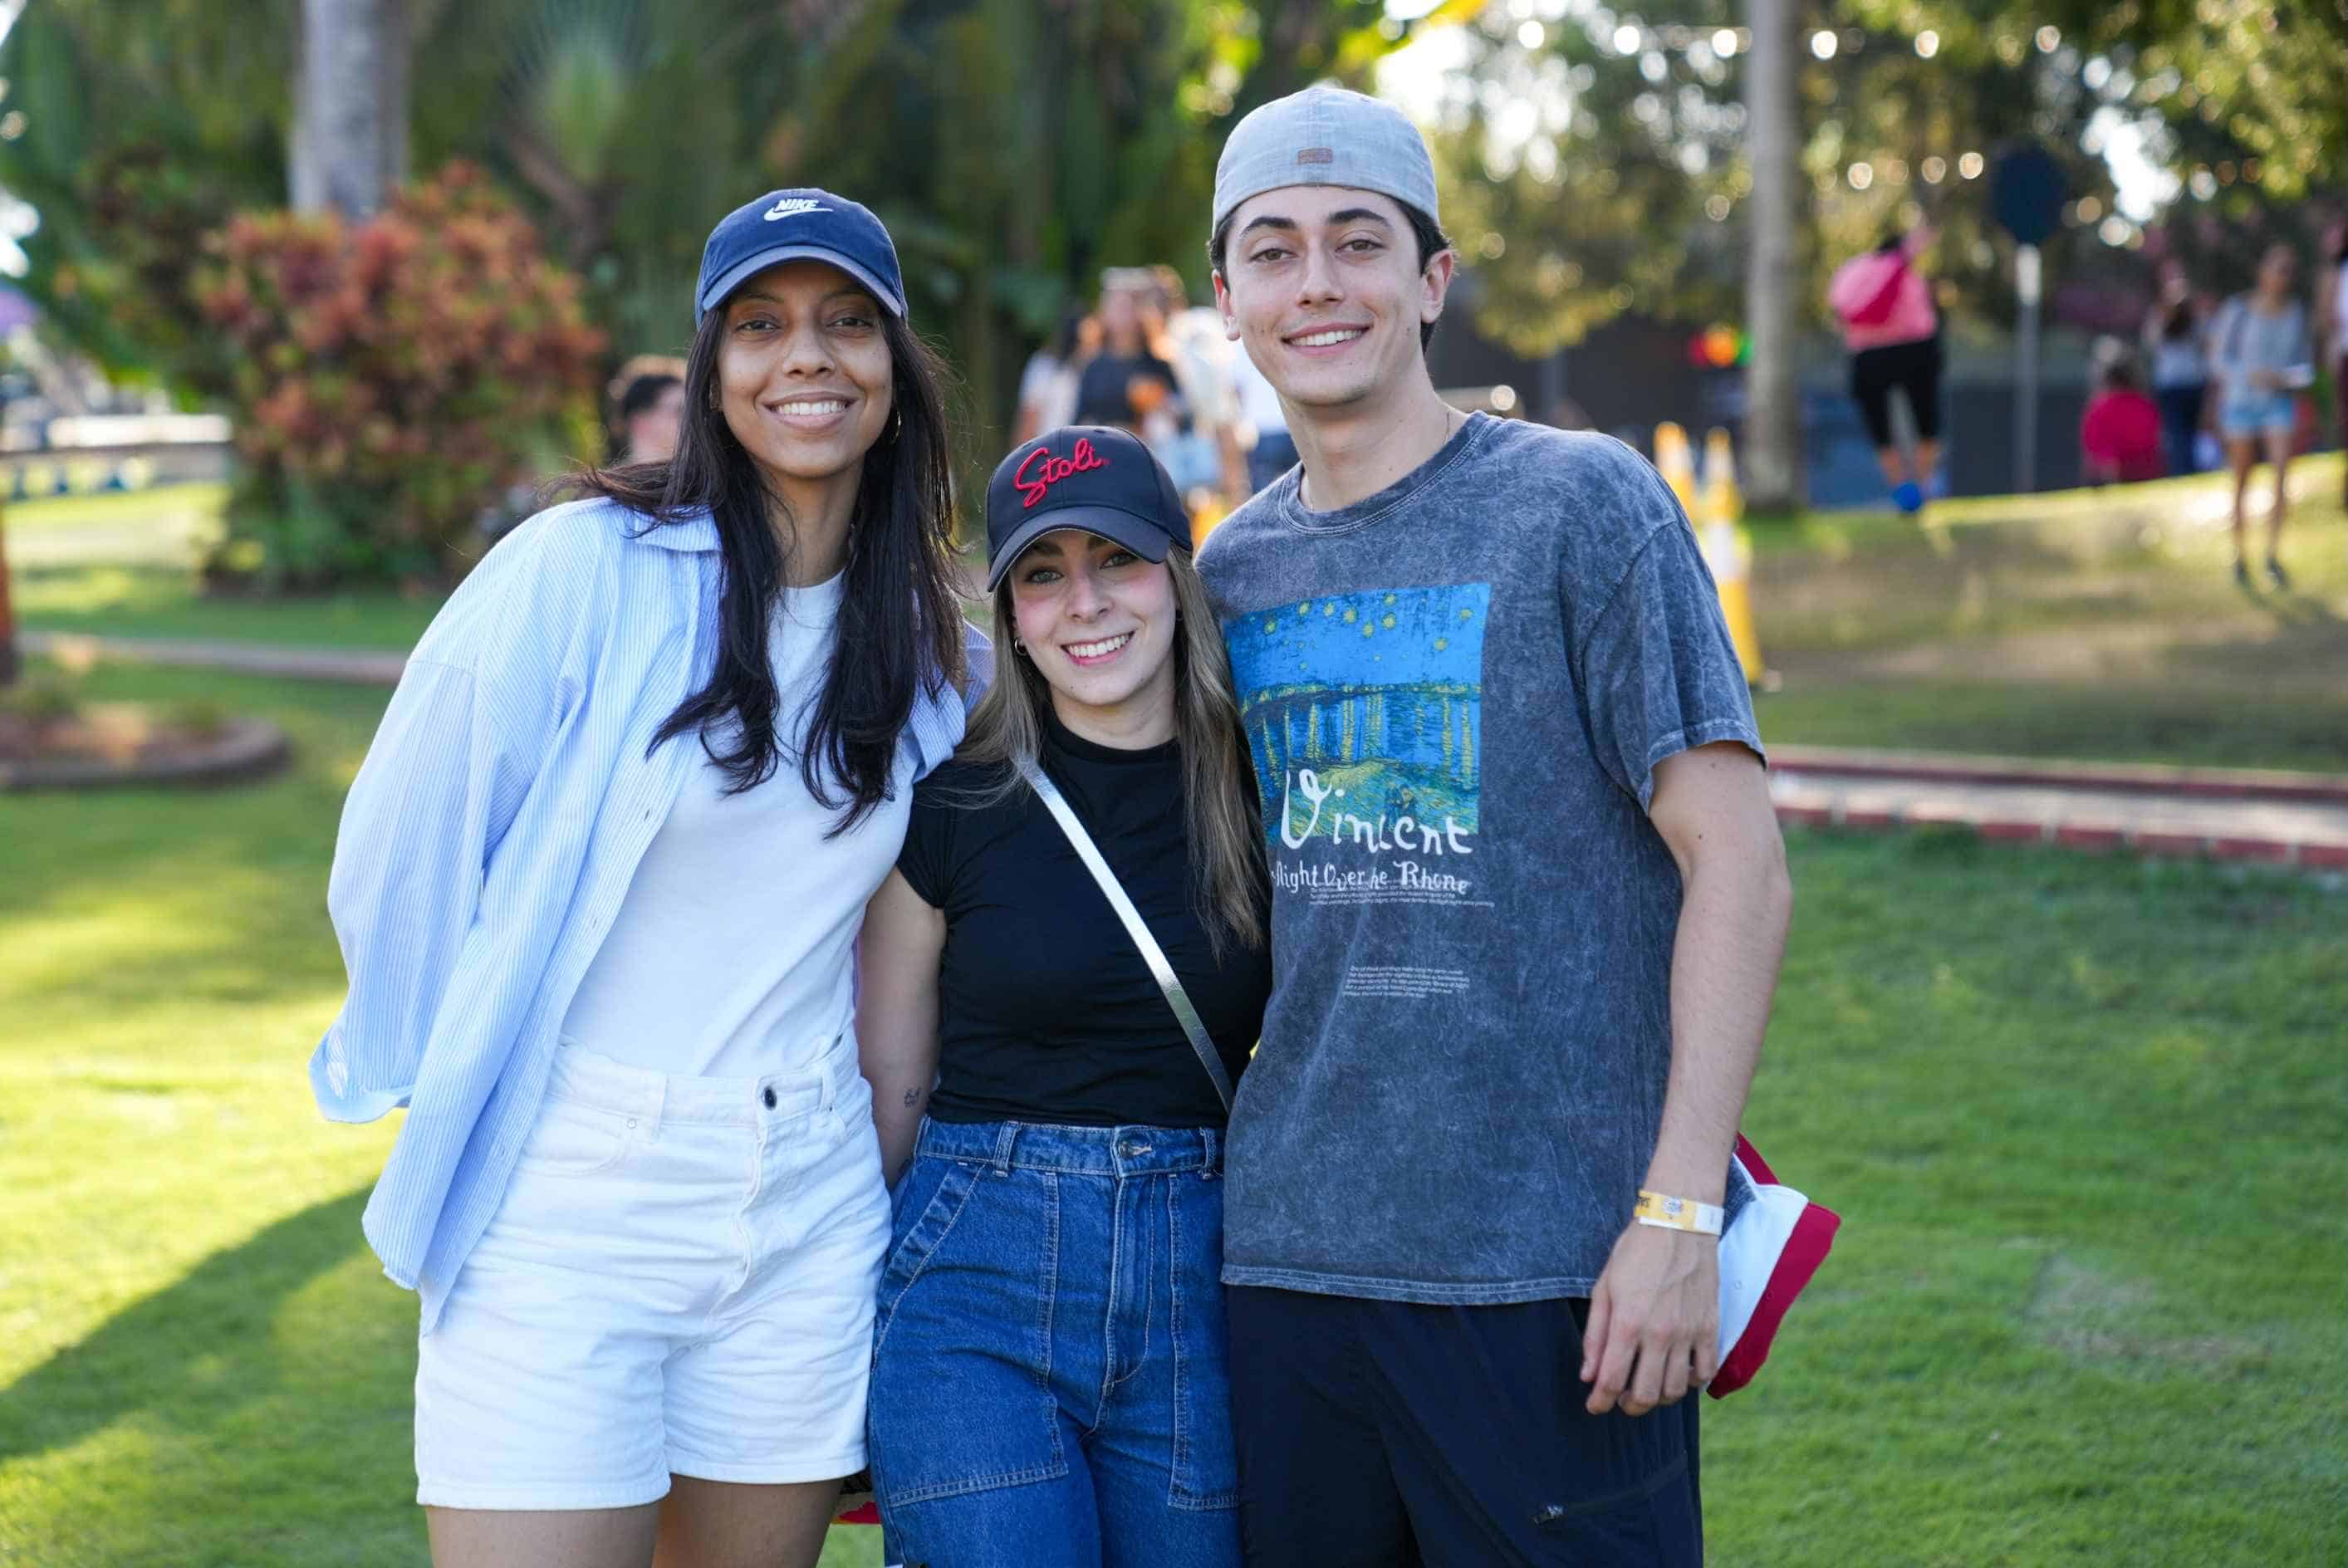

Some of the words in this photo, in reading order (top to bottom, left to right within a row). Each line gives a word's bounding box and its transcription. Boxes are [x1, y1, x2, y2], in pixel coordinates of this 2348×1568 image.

[774, 198, 819, 212] NIKE
[1014, 438, 1104, 508] Stoli
[1324, 862, 1365, 891] Over
[1392, 860, 1471, 895] Rhone
